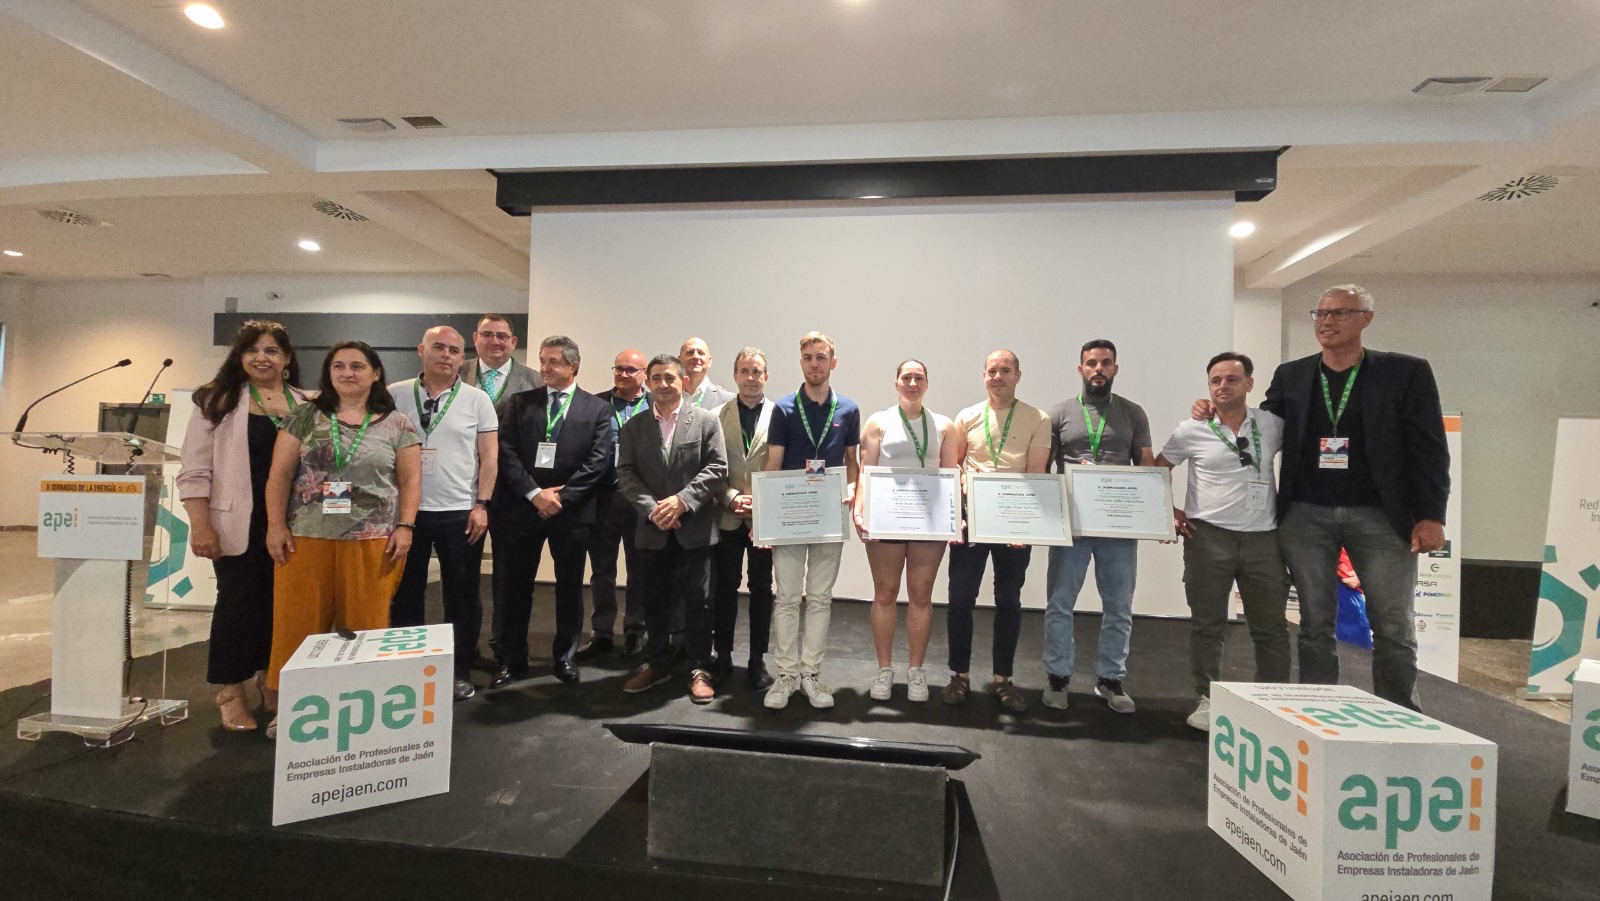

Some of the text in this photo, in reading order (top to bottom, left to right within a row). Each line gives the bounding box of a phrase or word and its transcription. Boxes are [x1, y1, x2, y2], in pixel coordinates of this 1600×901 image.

[78, 484, 85, 492] DE
[86, 484, 93, 492] LA
[94, 483, 116, 492] ENERGÍA
[43, 507, 78, 532] apei
[1580, 499, 1600, 510] Red
[367, 628, 444, 657] apei
[288, 664, 437, 752] apei
[1278, 703, 1441, 736] apei
[287, 740, 434, 770] Asociación de Profesionales de
[287, 751, 434, 782] Empresas Instaladoras de Jaén
[1214, 715, 1309, 816] apei
[311, 776, 408, 806] apejaen.com
[1338, 755, 1484, 849] apei
[1214, 773, 1308, 847] Asociación de Profesionales de
[1214, 784, 1307, 861] Empresas Instaladoras de Jaén
[1226, 818, 1286, 876] apejaen.com
[1338, 850, 1480, 862] Asociación de Profesionales de
[1337, 864, 1479, 877] Empresas Instaladoras de Jaén
[1362, 890, 1454, 901] apejaen.com
